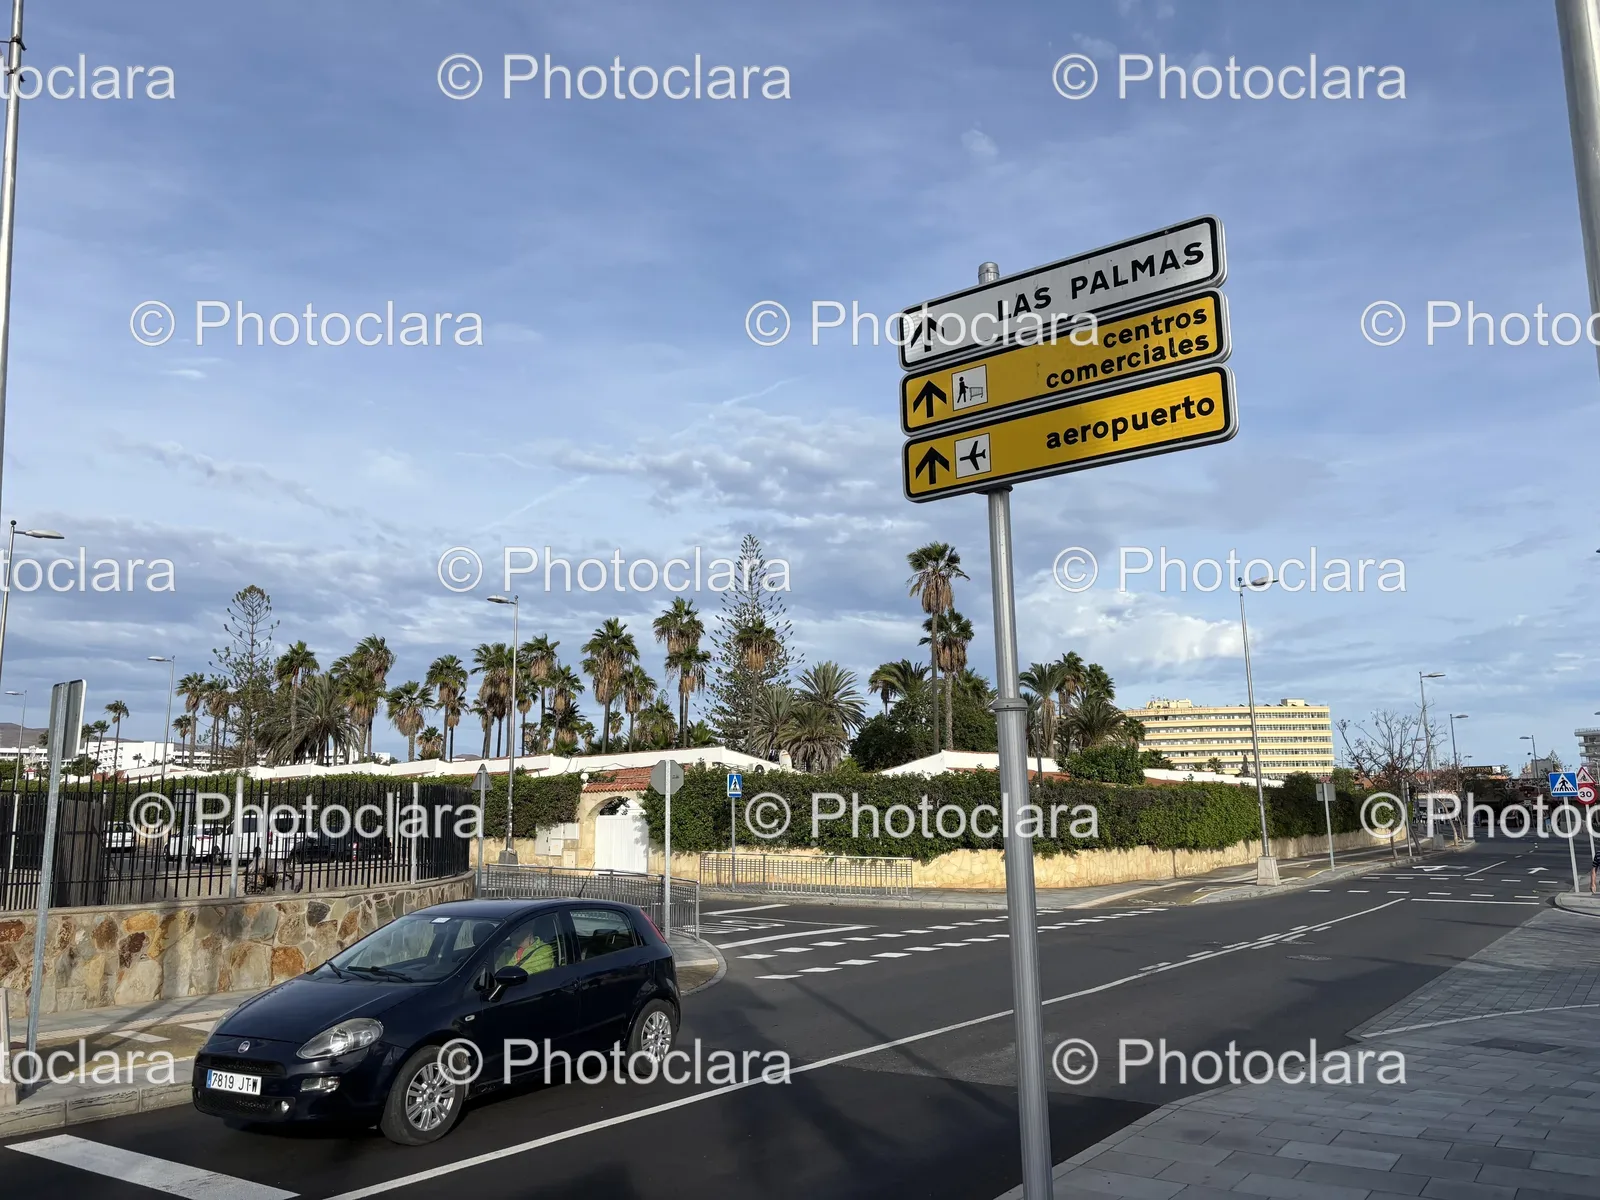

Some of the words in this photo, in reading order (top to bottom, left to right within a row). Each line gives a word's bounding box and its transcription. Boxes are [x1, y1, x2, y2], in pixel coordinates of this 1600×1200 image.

[997, 286, 1052, 322] LAS
[1070, 241, 1204, 300] PALMAS
[1103, 308, 1208, 349] centros
[1046, 334, 1210, 389] comerciales
[1046, 395, 1215, 450] aeropuerto
[1580, 790, 1592, 798] 30
[212, 1072, 235, 1090] 7819
[238, 1076, 258, 1093] JTW
